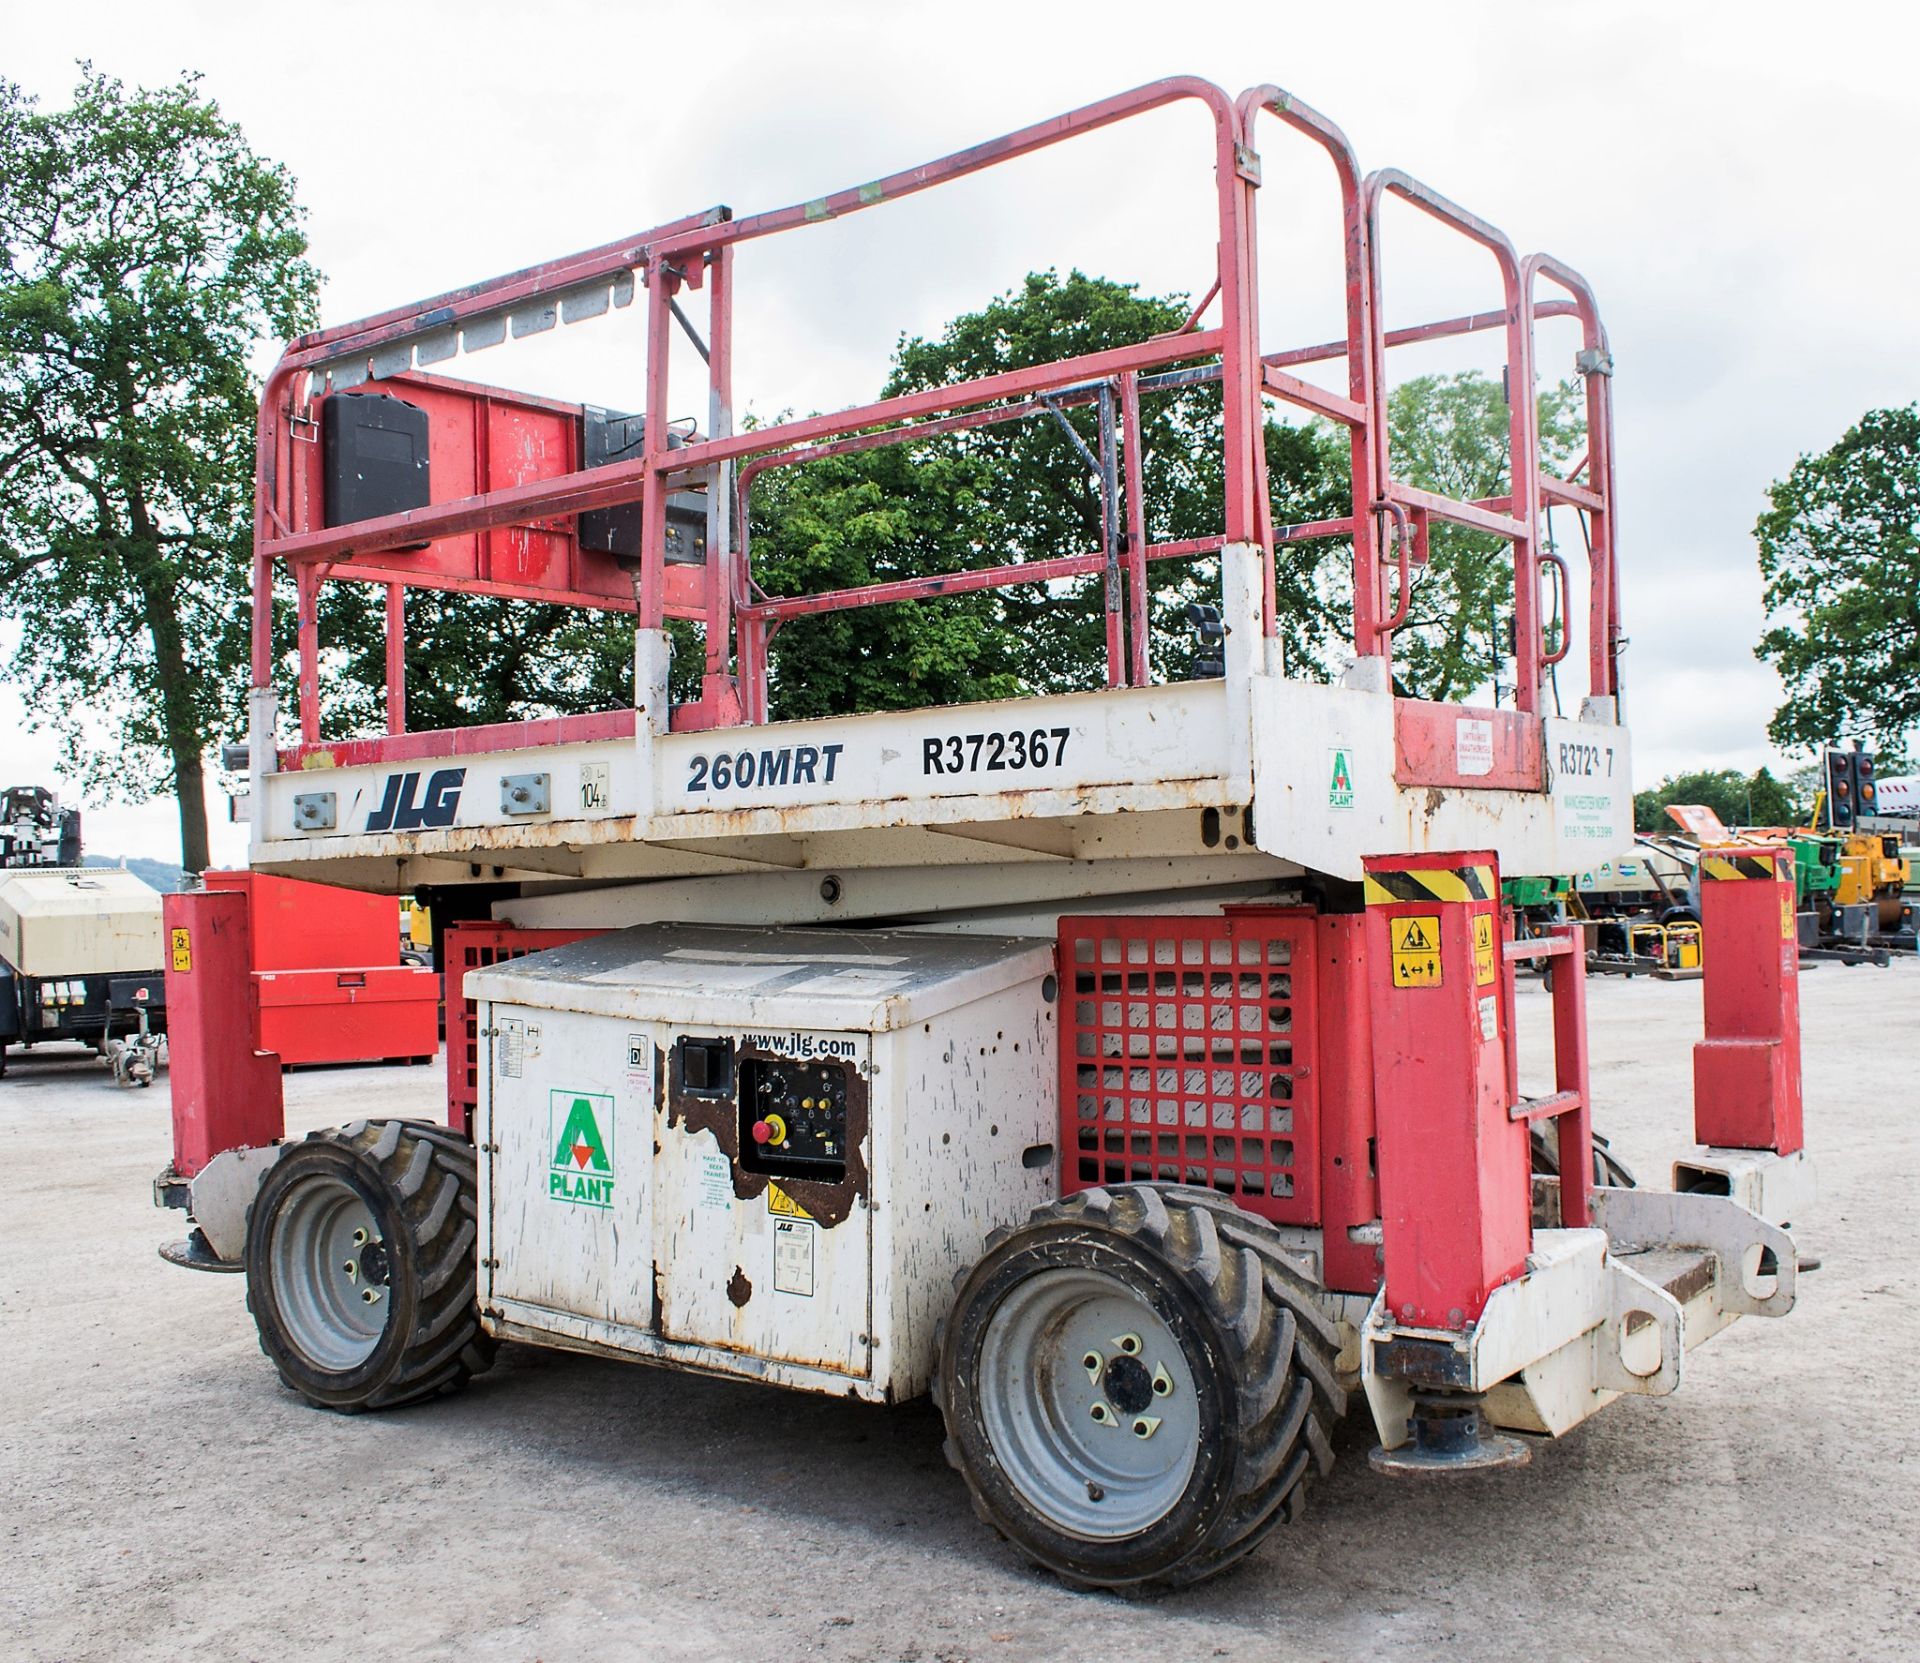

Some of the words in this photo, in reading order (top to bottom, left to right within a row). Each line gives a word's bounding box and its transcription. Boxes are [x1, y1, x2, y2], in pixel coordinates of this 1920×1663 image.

[923, 727, 1070, 775] R372367
[687, 744, 844, 792] 260MRT
[366, 767, 467, 831] JLG
[581, 783, 600, 808] 104
[1329, 794, 1354, 806] PLANT
[550, 1173, 615, 1203] PLANT
[777, 1223, 793, 1232] JLG
